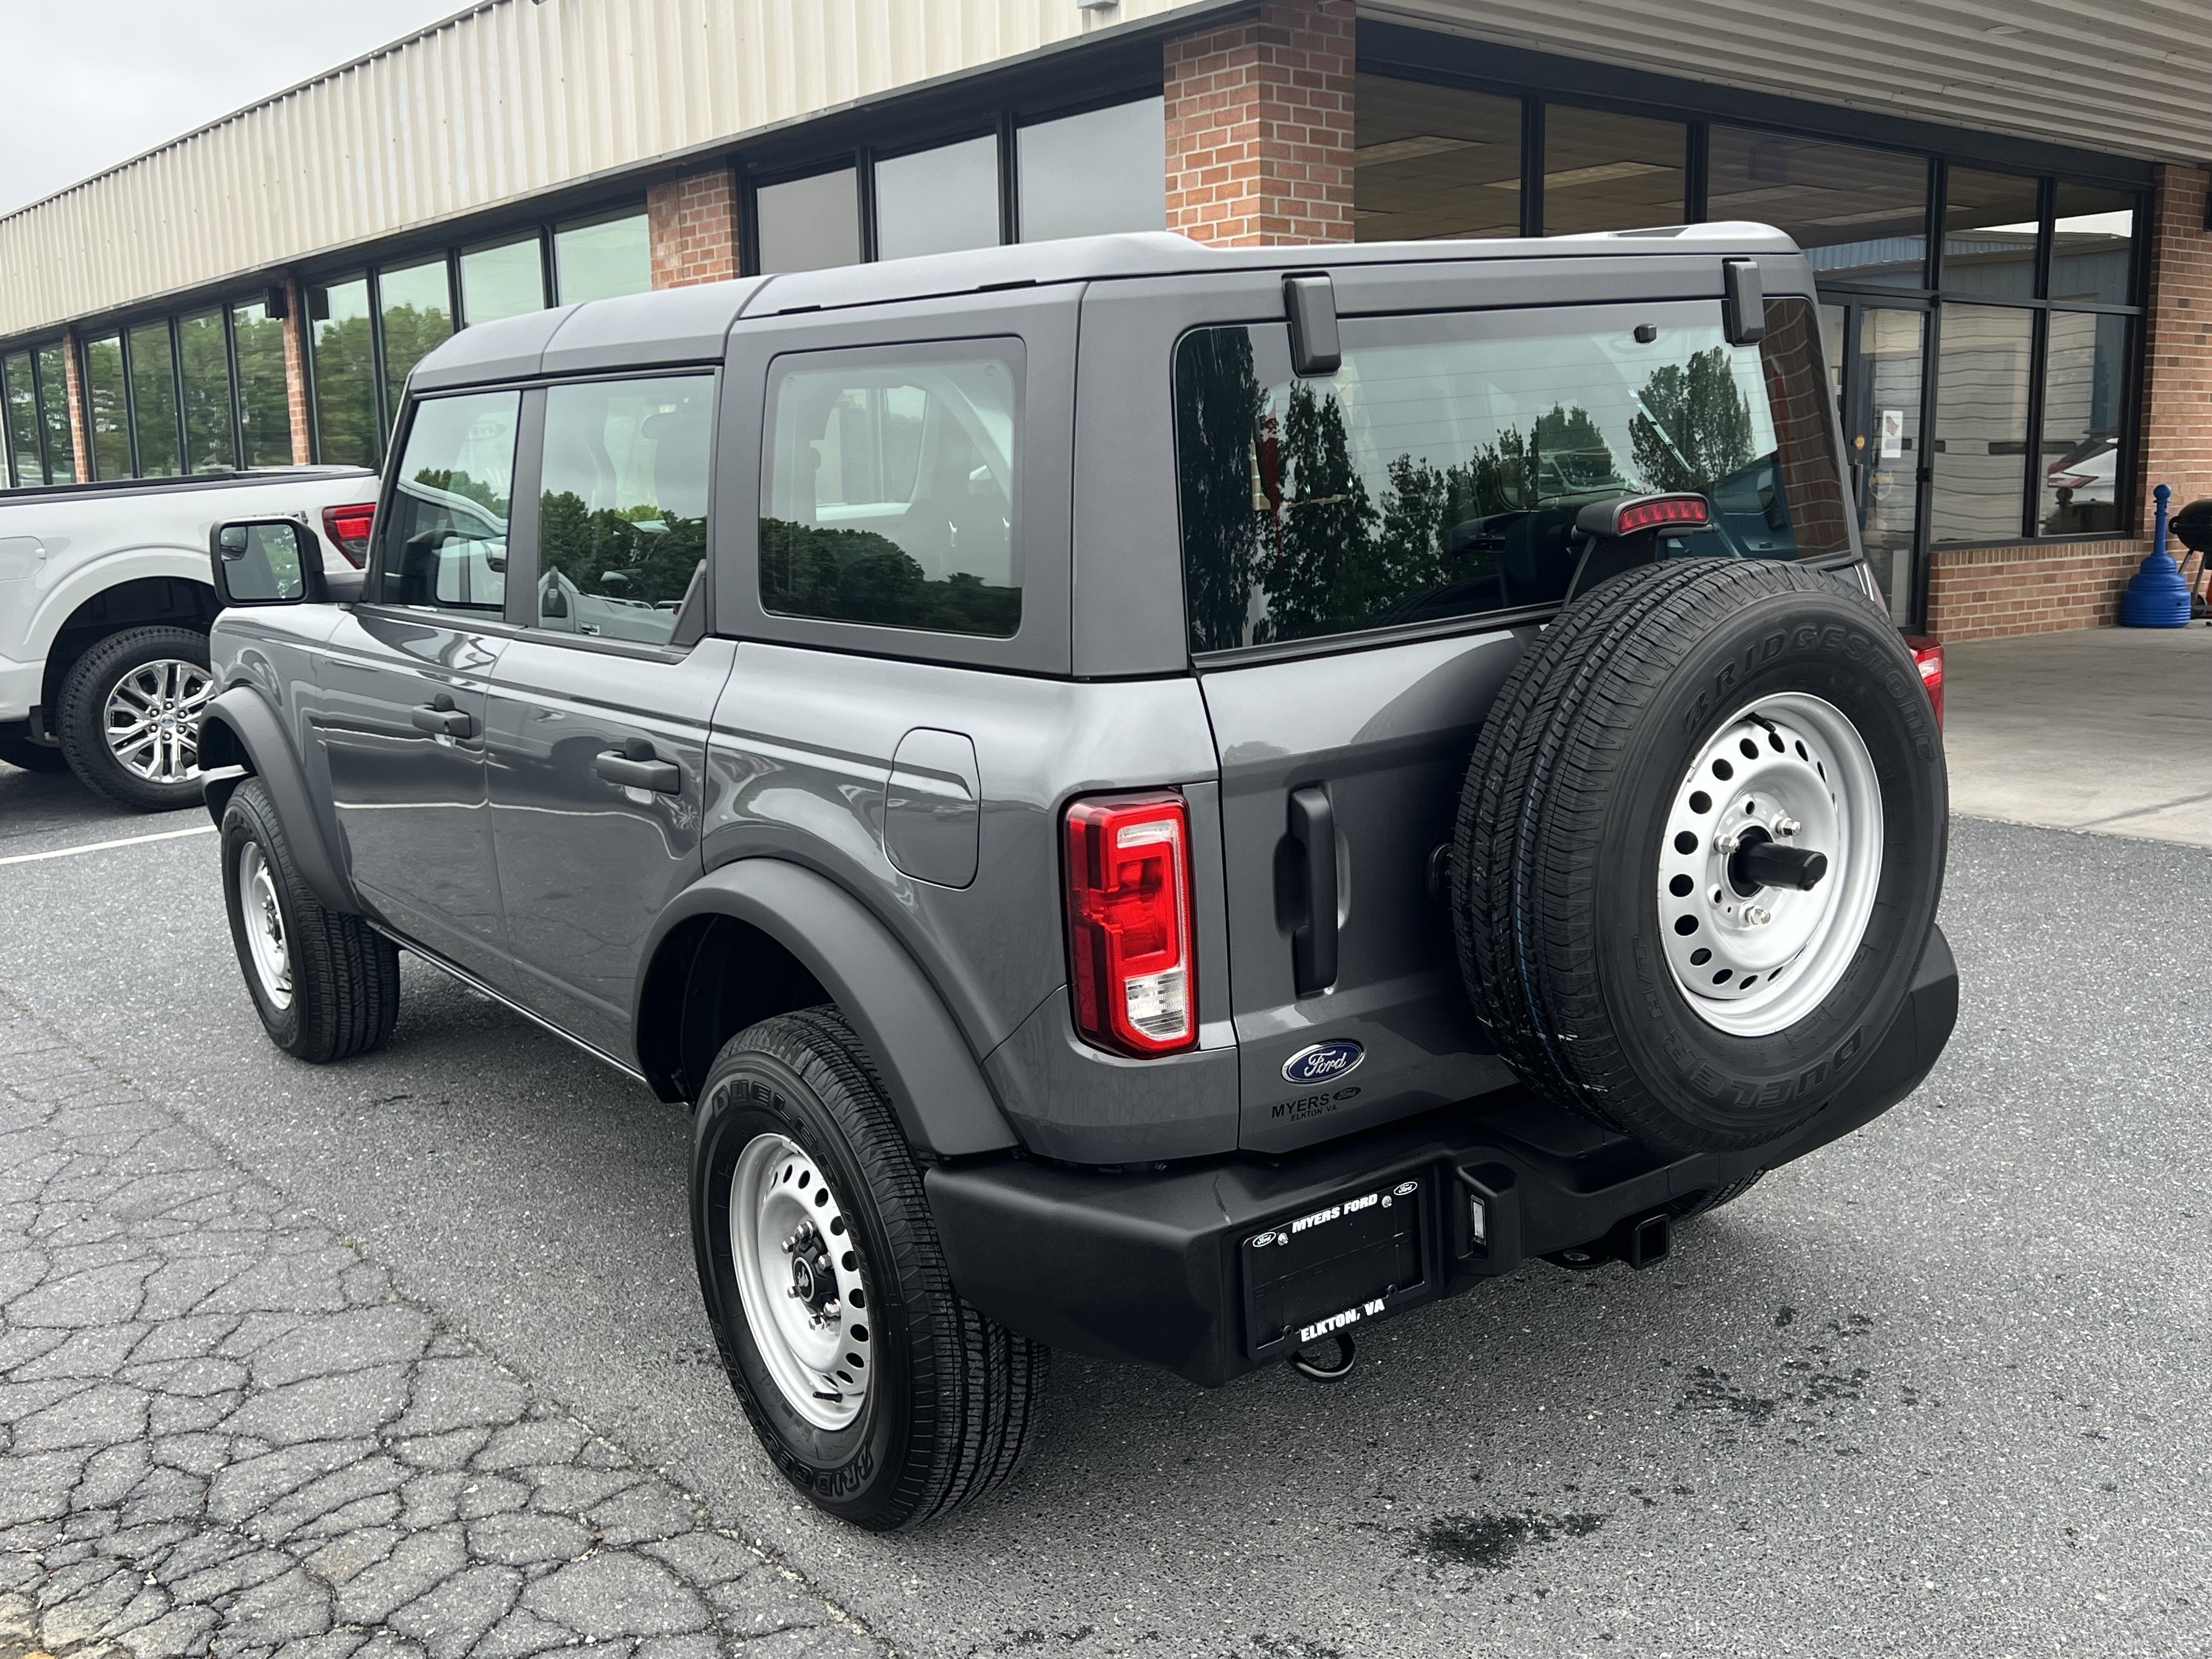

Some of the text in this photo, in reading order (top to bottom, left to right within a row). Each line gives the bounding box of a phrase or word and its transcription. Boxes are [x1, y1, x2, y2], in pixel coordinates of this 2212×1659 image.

[1684, 623, 1936, 761] BRIDGESTONE
[1303, 1049, 1347, 1077] Ford
[1662, 1024, 1864, 1109] DUELER
[1271, 1093, 1330, 1119] MYERS
[1291, 1108, 1323, 1121] ELKTON
[712, 1079, 842, 1192] DUELER
[1291, 1206, 1340, 1234] MYERS
[1343, 1193, 1378, 1215] FORD
[1300, 1298, 1385, 1342] ELKTON, VA
